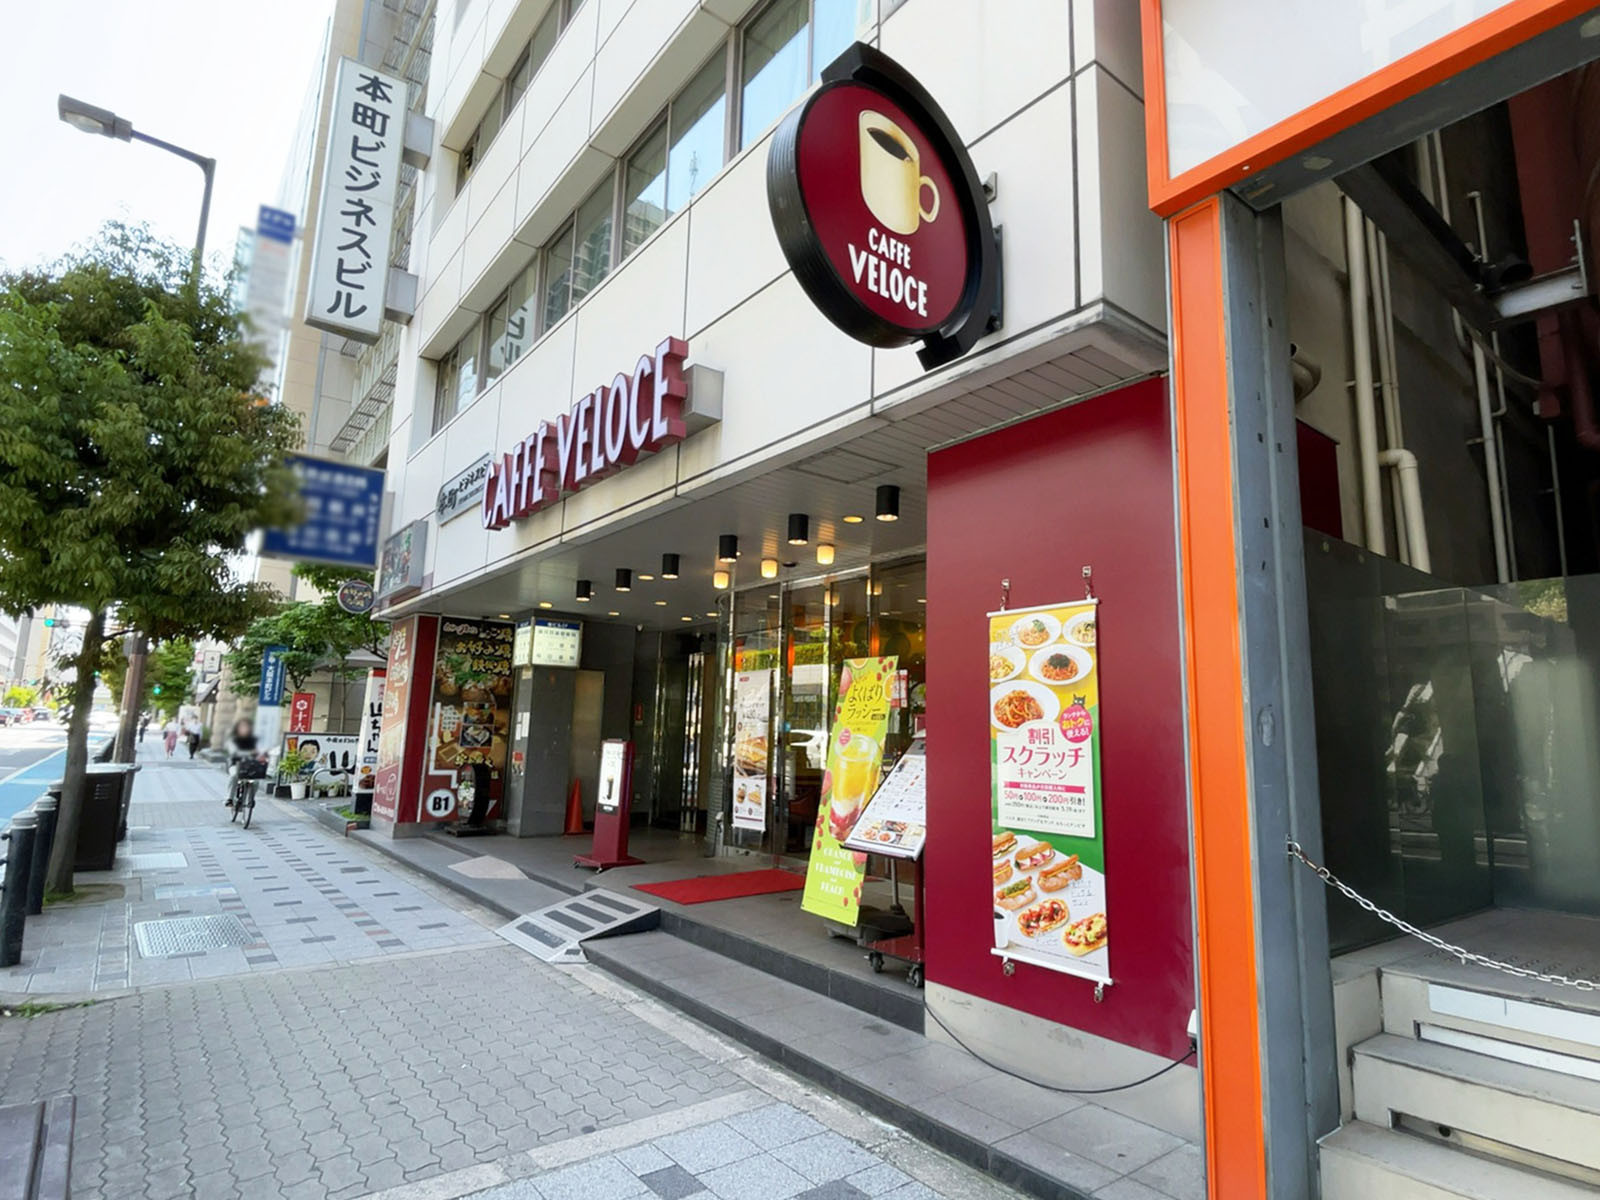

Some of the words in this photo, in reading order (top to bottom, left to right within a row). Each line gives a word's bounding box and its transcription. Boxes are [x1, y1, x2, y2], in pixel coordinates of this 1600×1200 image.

[327, 73, 393, 318] 本町ビジネスビル
[848, 243, 928, 318] VELOCE
[557, 336, 674, 490] VELOCE
[848, 683, 884, 704] よくばり
[847, 703, 881, 721] ラッシー
[1061, 717, 1091, 730] おトクに
[1028, 728, 1055, 746] 割引
[1003, 745, 1085, 768] スクラッチ
[1017, 767, 1067, 780] キャンペーン
[432, 796, 449, 811] B1
